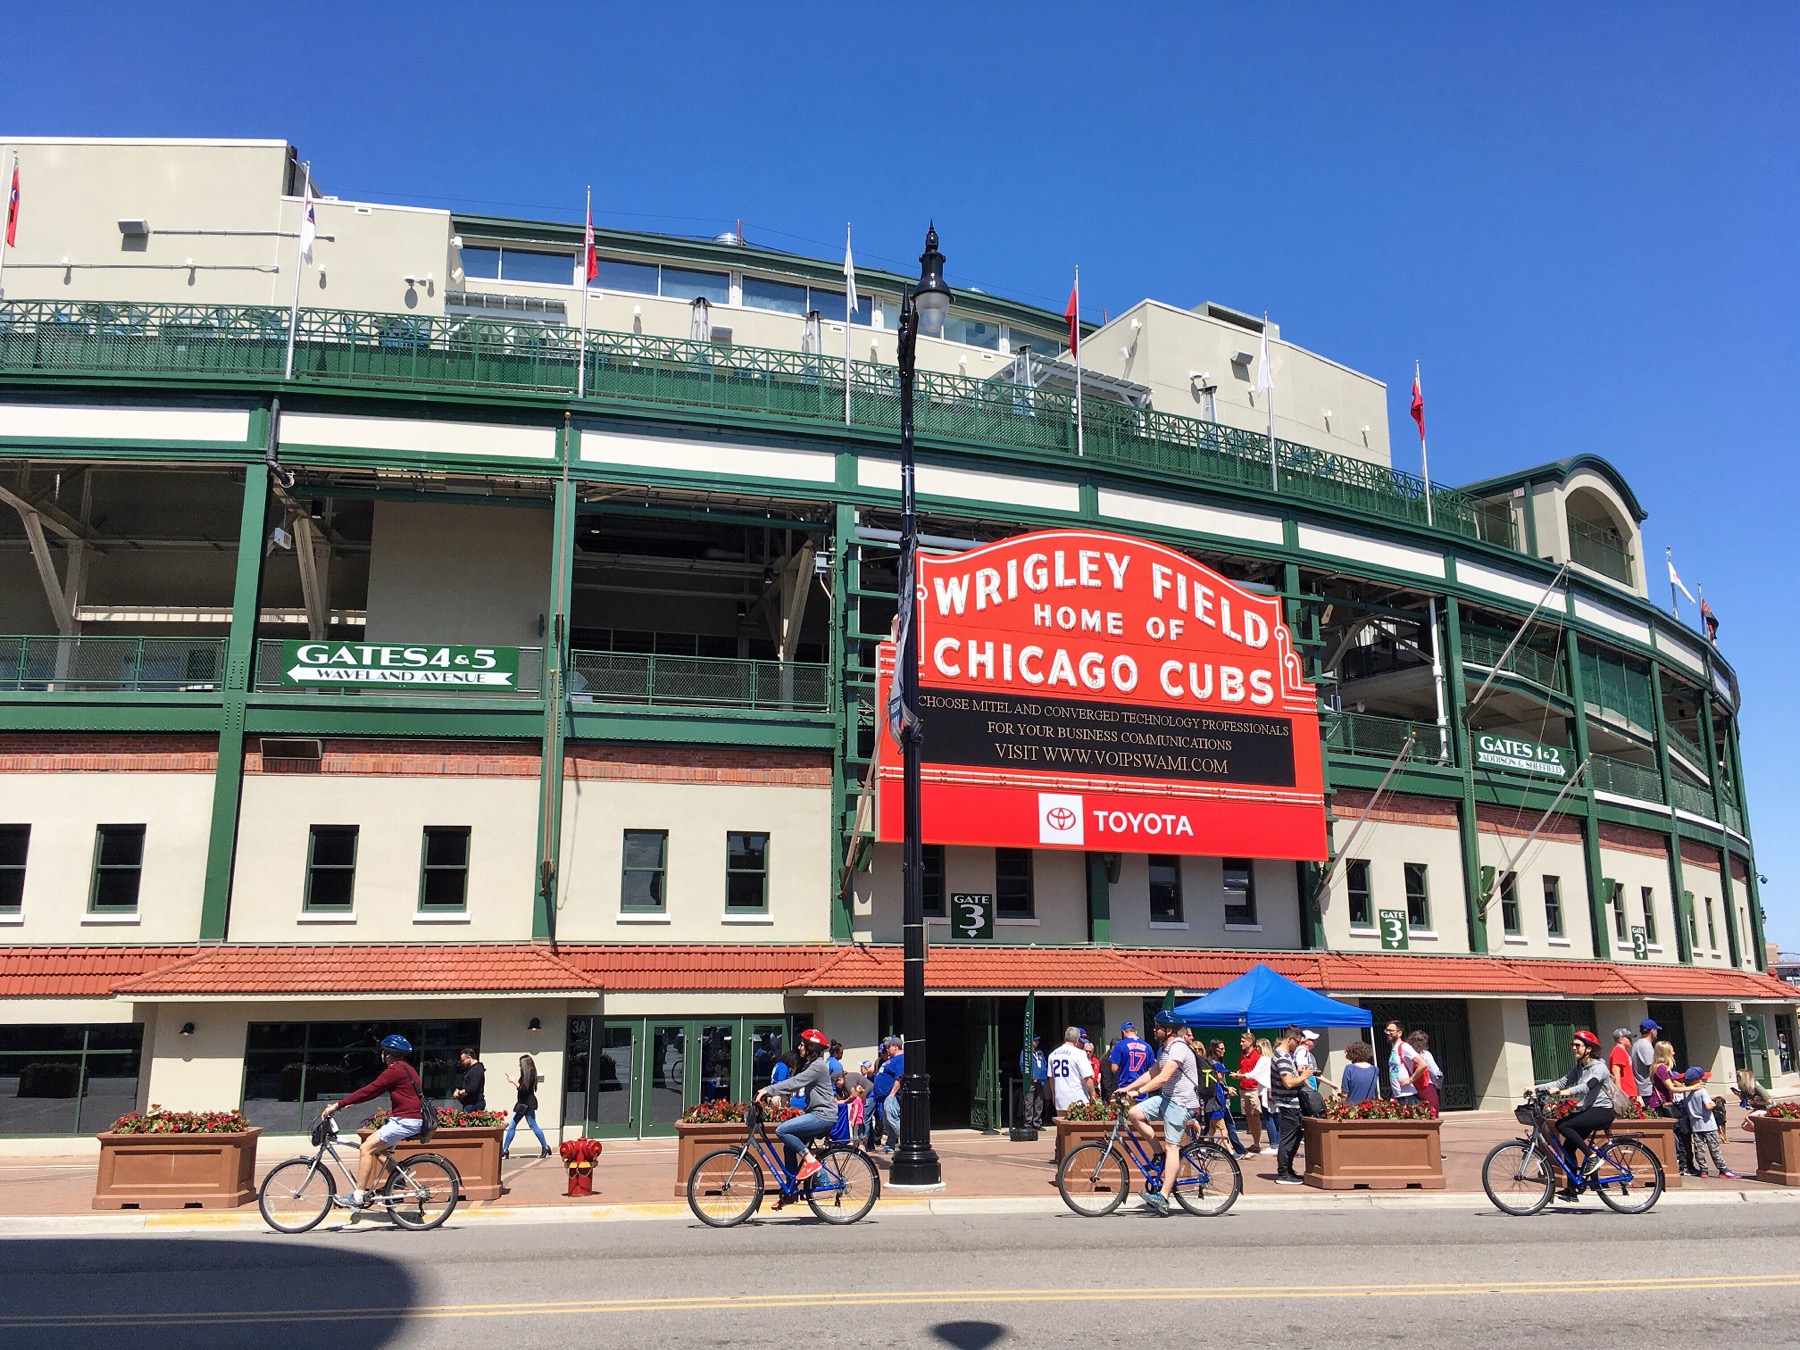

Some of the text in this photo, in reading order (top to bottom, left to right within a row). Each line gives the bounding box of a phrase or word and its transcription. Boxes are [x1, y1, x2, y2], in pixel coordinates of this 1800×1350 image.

[933, 550, 1269, 649] WRIGLEY FIELD
[1034, 603, 1185, 641] HOME OF
[317, 669, 487, 683] WAVELAND AVENUE
[933, 637, 1275, 705] CHICAGO CUBS
[918, 695, 1290, 737] CHOOSE MITEL AND CONVERGED TECHNOLOGY PROFESSIONALS
[987, 721, 1232, 751] FOR YOUR BUSINESS COMMUNICATIONS
[1480, 736, 1533, 758] GATES
[995, 743, 1229, 774] VISIT WWW.VOIPSWAMI.COM
[1481, 753, 1516, 766] ADDISON
[1525, 761, 1562, 774] SHEFFIELD
[1093, 810, 1194, 836] TOYOTA
[953, 895, 990, 904] GATE
[959, 904, 986, 929] 3
[1380, 911, 1405, 919] GATE
[1385, 918, 1404, 941] 3
[1634, 933, 1646, 953] 3
[572, 1020, 586, 1034] 3A
[1053, 1059, 1070, 1077] 26
[1128, 1051, 1147, 1072] 17
